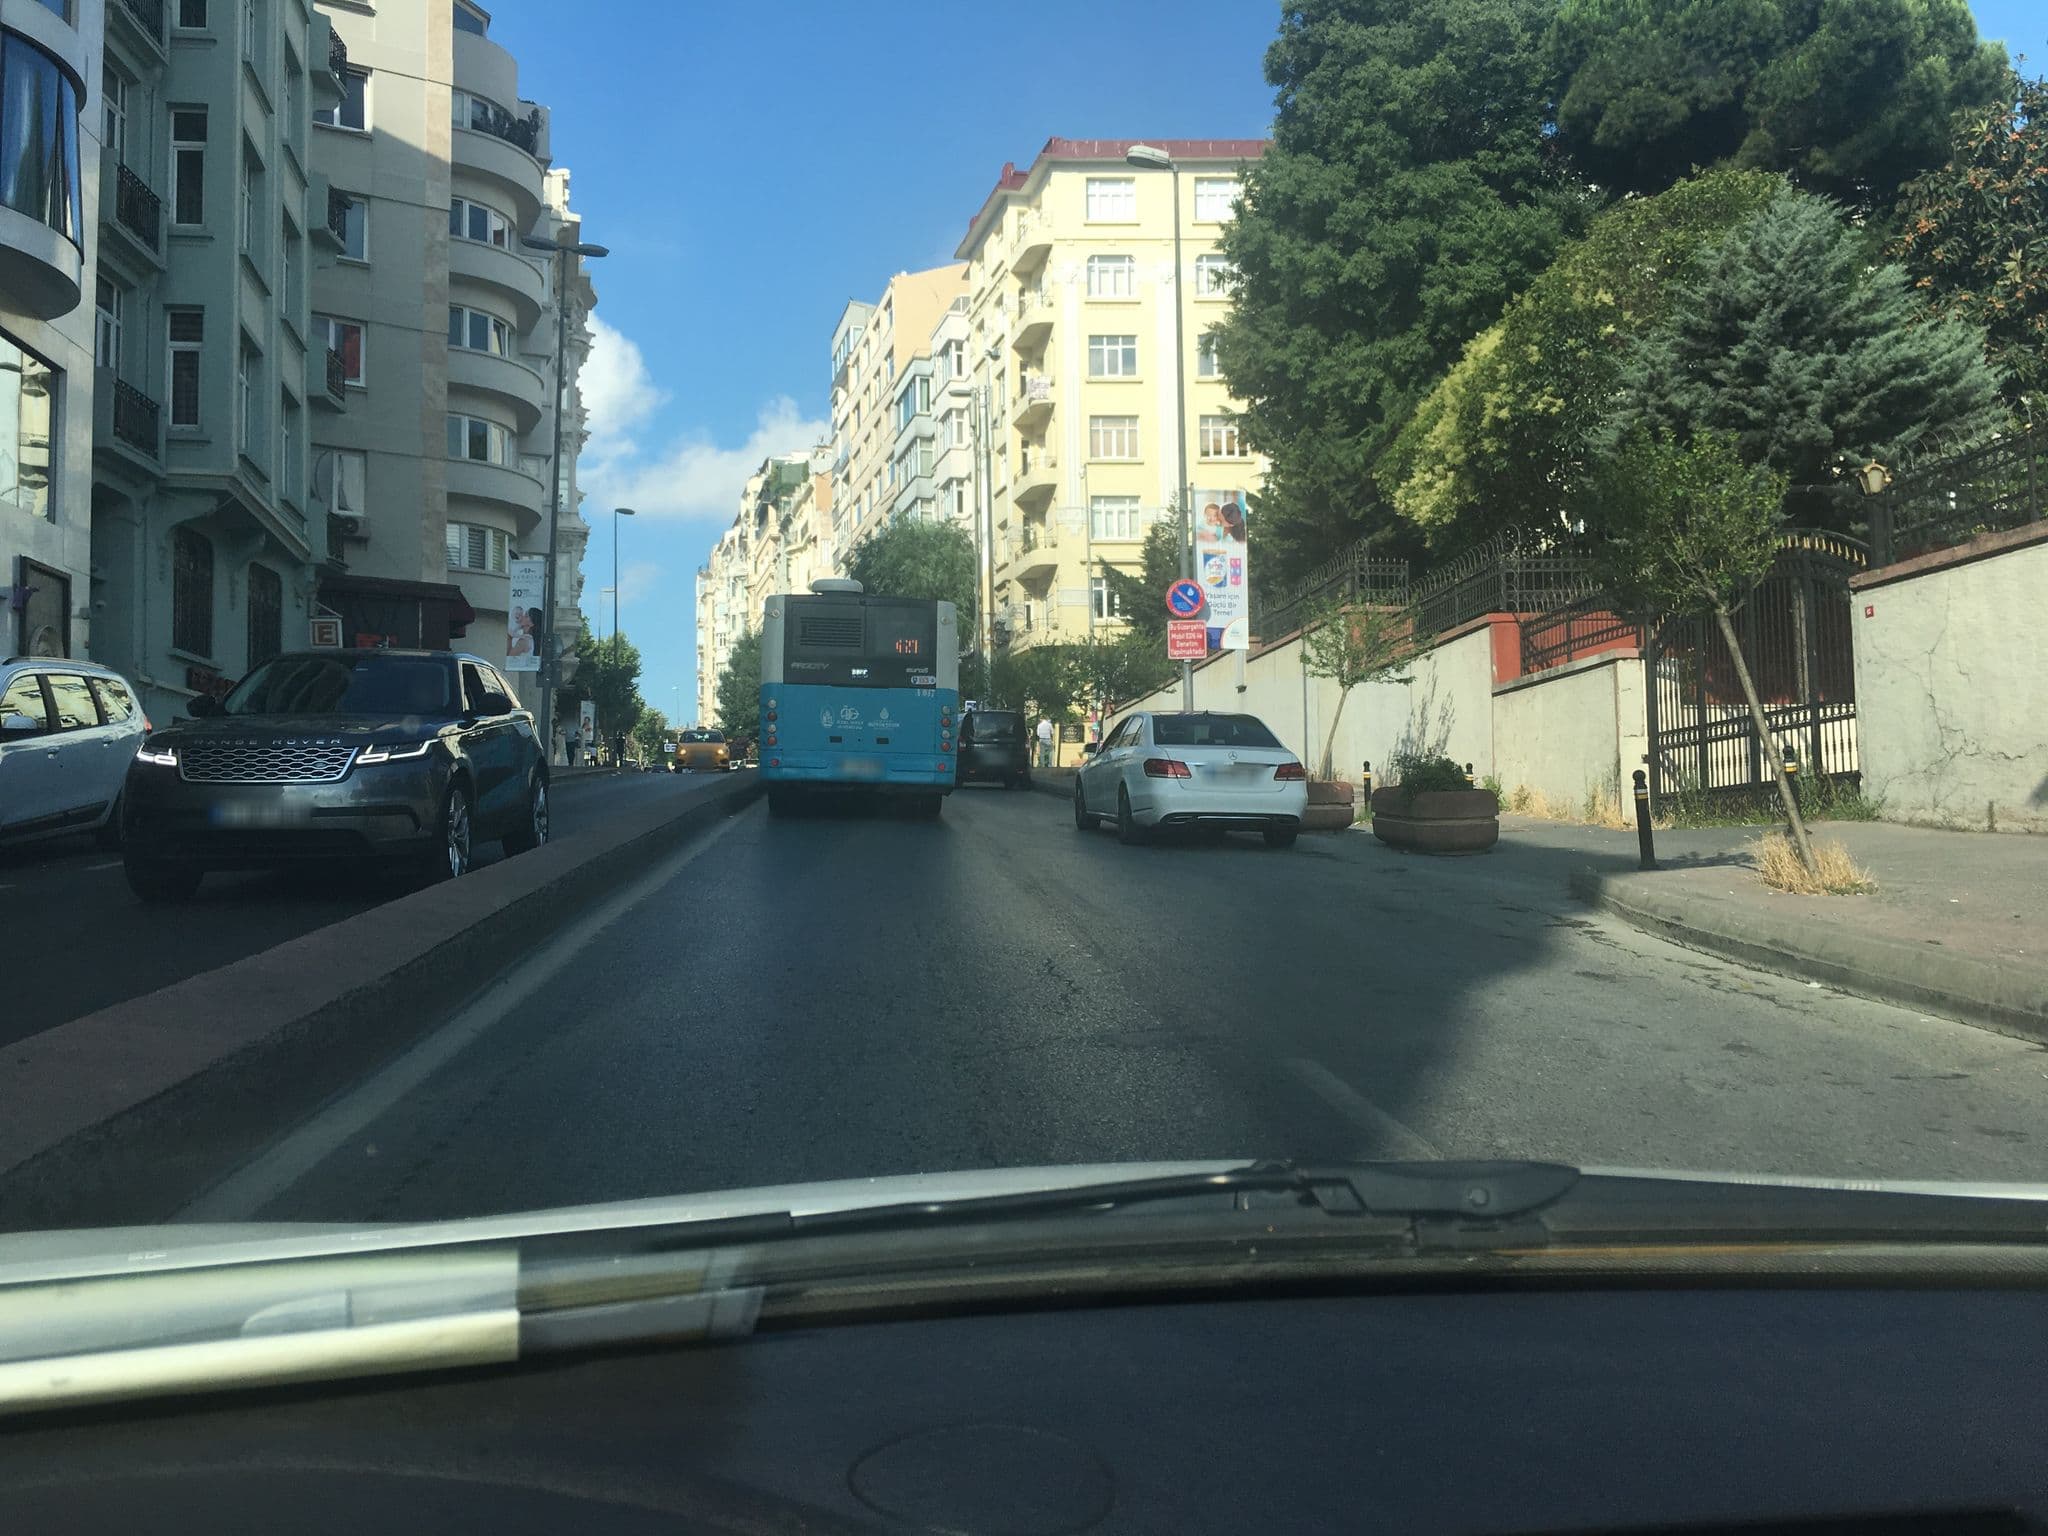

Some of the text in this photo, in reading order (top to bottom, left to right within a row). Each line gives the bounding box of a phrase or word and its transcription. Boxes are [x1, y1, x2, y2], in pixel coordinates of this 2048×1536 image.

[512, 589, 522, 597] 20
[1213, 609, 1233, 617] Temel
[317, 624, 333, 643] E
